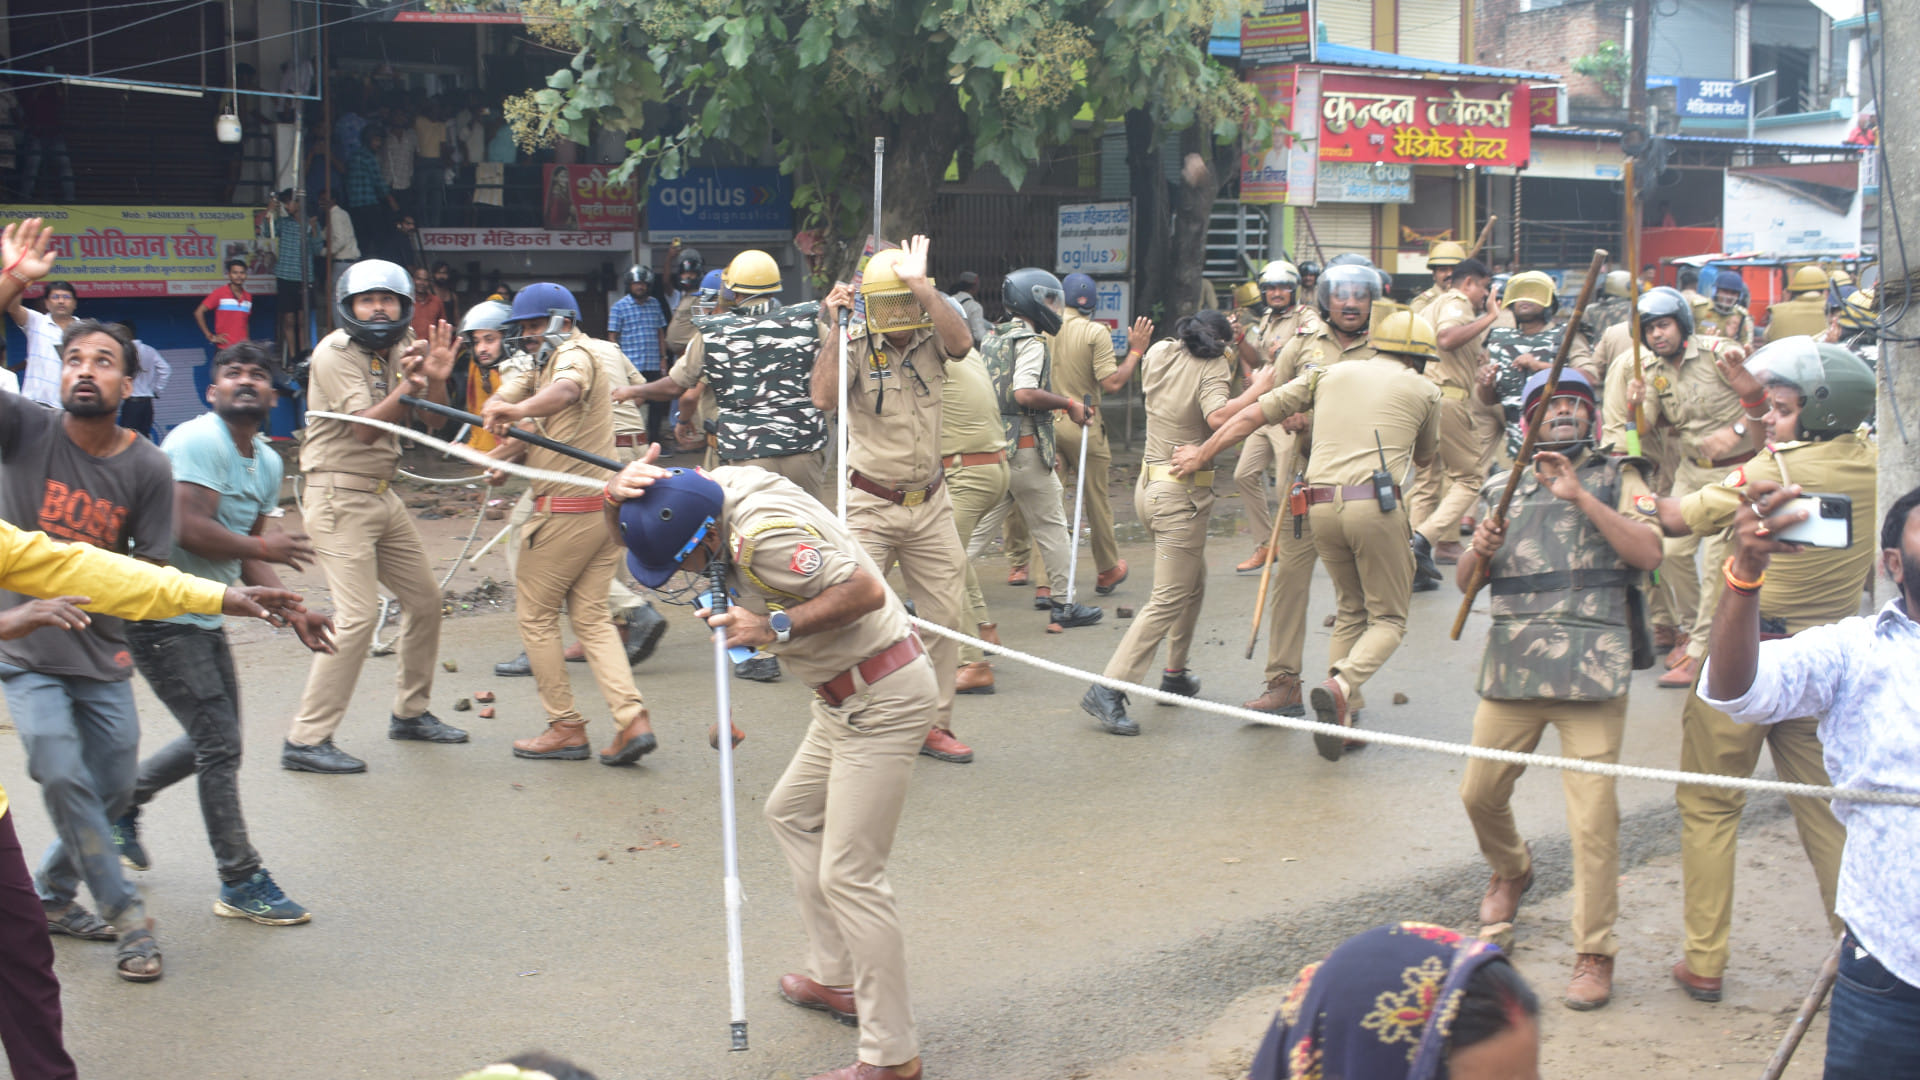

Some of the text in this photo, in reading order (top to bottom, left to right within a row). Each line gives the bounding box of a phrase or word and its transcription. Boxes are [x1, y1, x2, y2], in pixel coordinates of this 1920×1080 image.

[1699, 80, 1735, 98] अमर
[1322, 91, 1416, 134] कुन्दन
[1456, 129, 1508, 160] सेन्टर
[660, 177, 746, 216] agilus
[698, 209, 779, 223] diagnostics
[77, 227, 167, 259] प्रोविजन
[169, 227, 217, 258] स्टोर
[423, 232, 477, 247] प्रकाश
[1062, 243, 1109, 269] agilus
[38, 479, 128, 542] BOSS
